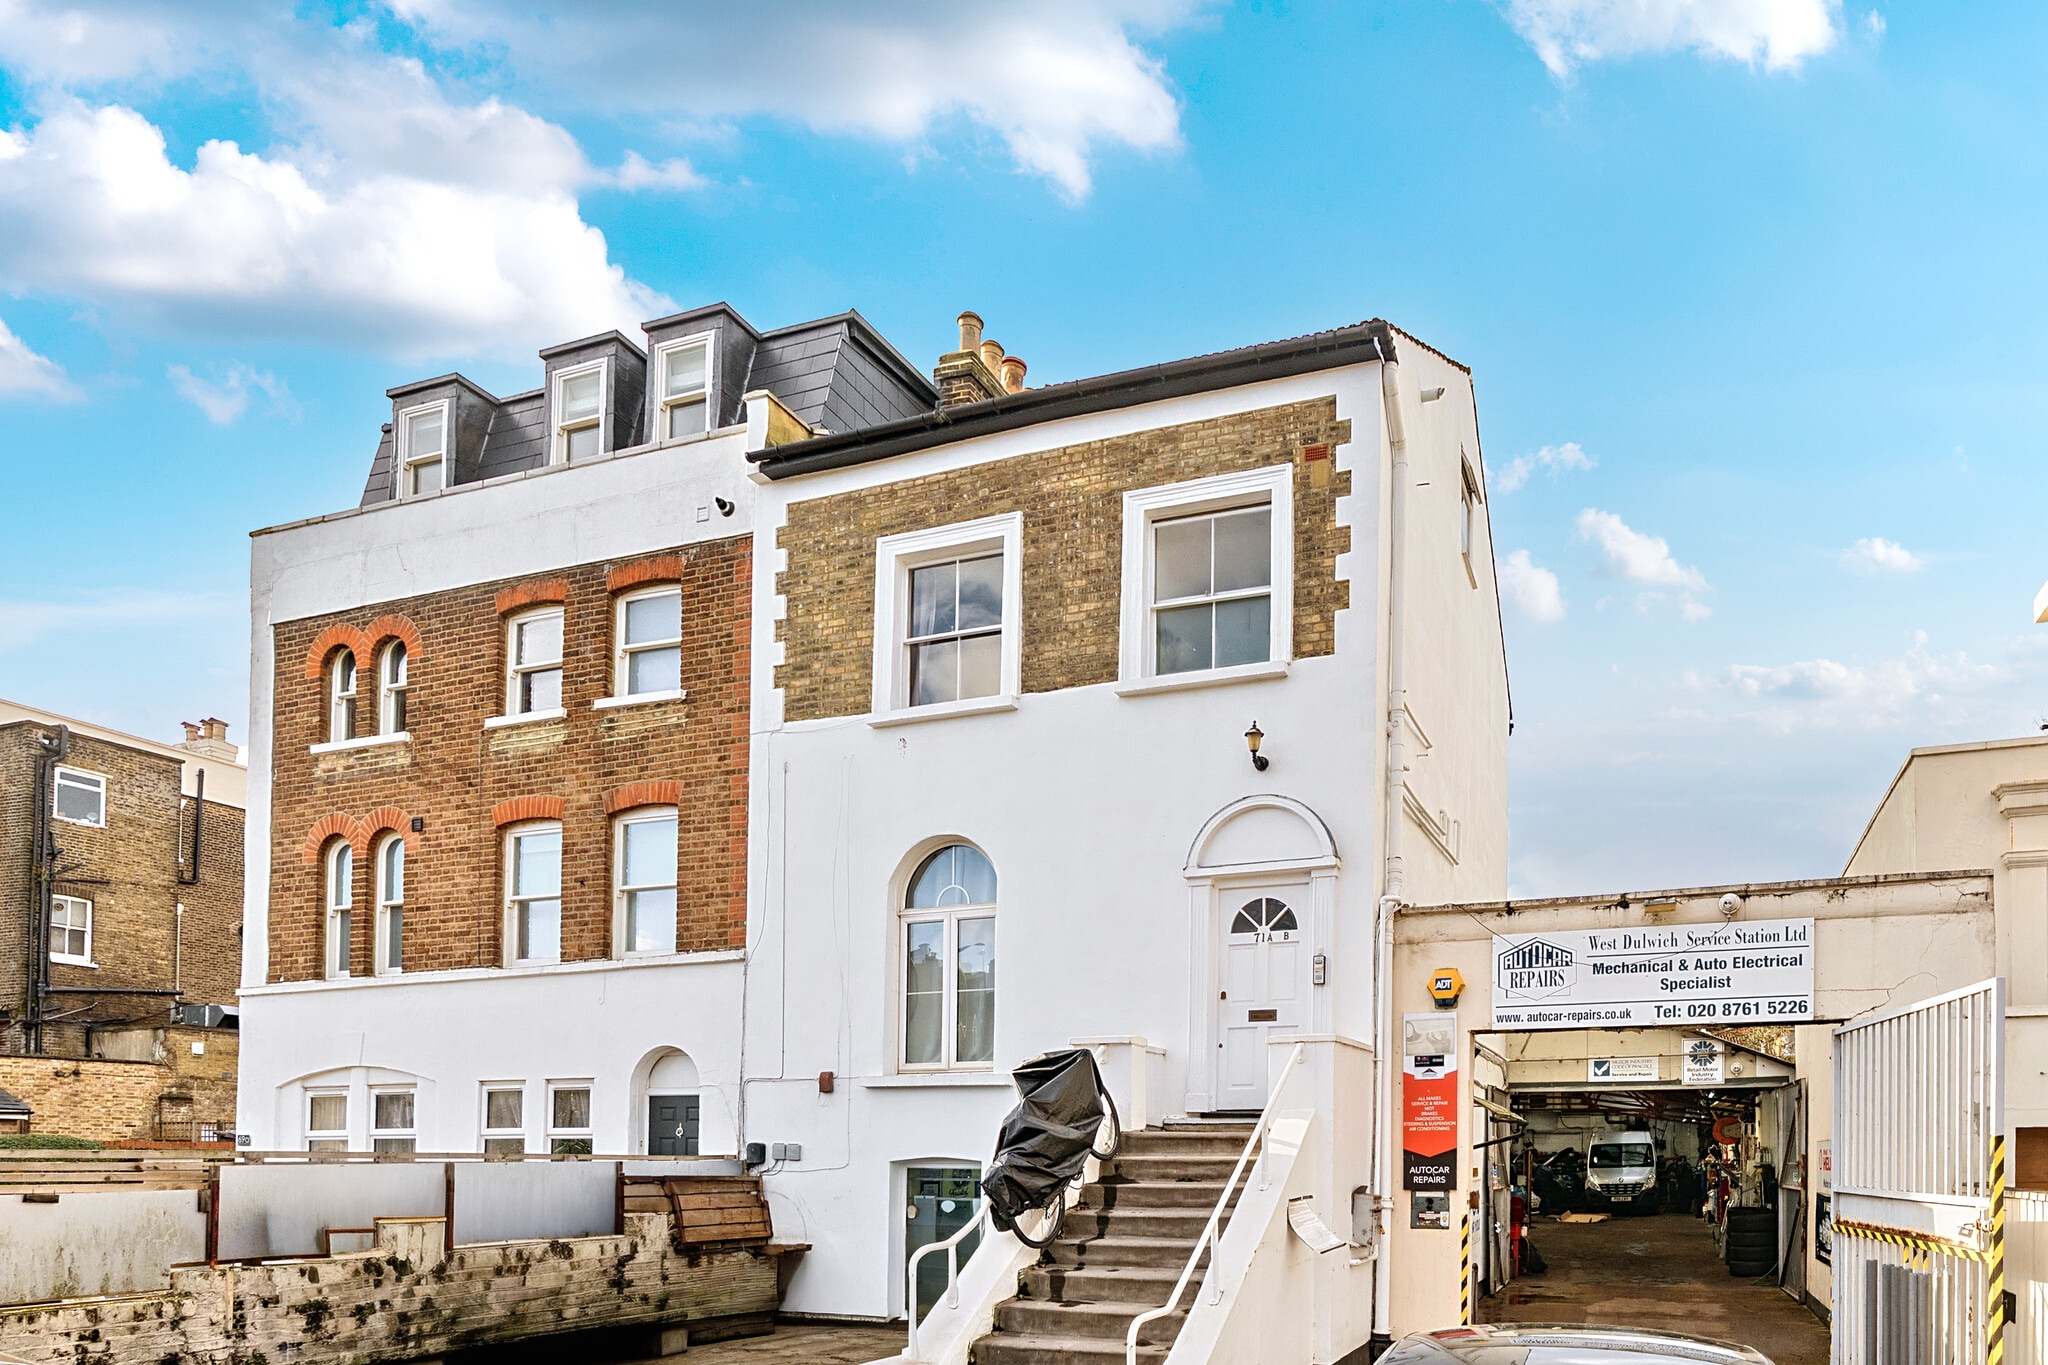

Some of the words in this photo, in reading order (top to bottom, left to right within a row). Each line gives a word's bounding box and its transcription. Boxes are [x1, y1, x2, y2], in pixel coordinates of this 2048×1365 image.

[1588, 935, 1617, 951] West
[1623, 932, 1678, 950] Dulwich
[1686, 930, 1731, 946] Service
[1734, 927, 1780, 944] Station
[1784, 925, 1807, 942] Ltd
[1504, 943, 1572, 970] AUTOCAR
[1592, 959, 1673, 975] Mechanical
[1678, 958, 1689, 971] &
[1693, 957, 1728, 971] Auto
[1732, 953, 1803, 969] Electrical
[1435, 979, 1452, 989] ADT
[1510, 969, 1565, 989] REPAIRS
[1660, 975, 1732, 992] Specialist
[1654, 1005, 1681, 1018] Tel:
[1687, 1003, 1717, 1018] 020
[1722, 1001, 1760, 1016] 8761
[1767, 1000, 1808, 1015] 5226
[1409, 1166, 1450, 1174] AUTOCAR
[1413, 1175, 1446, 1183] REPAIRS
